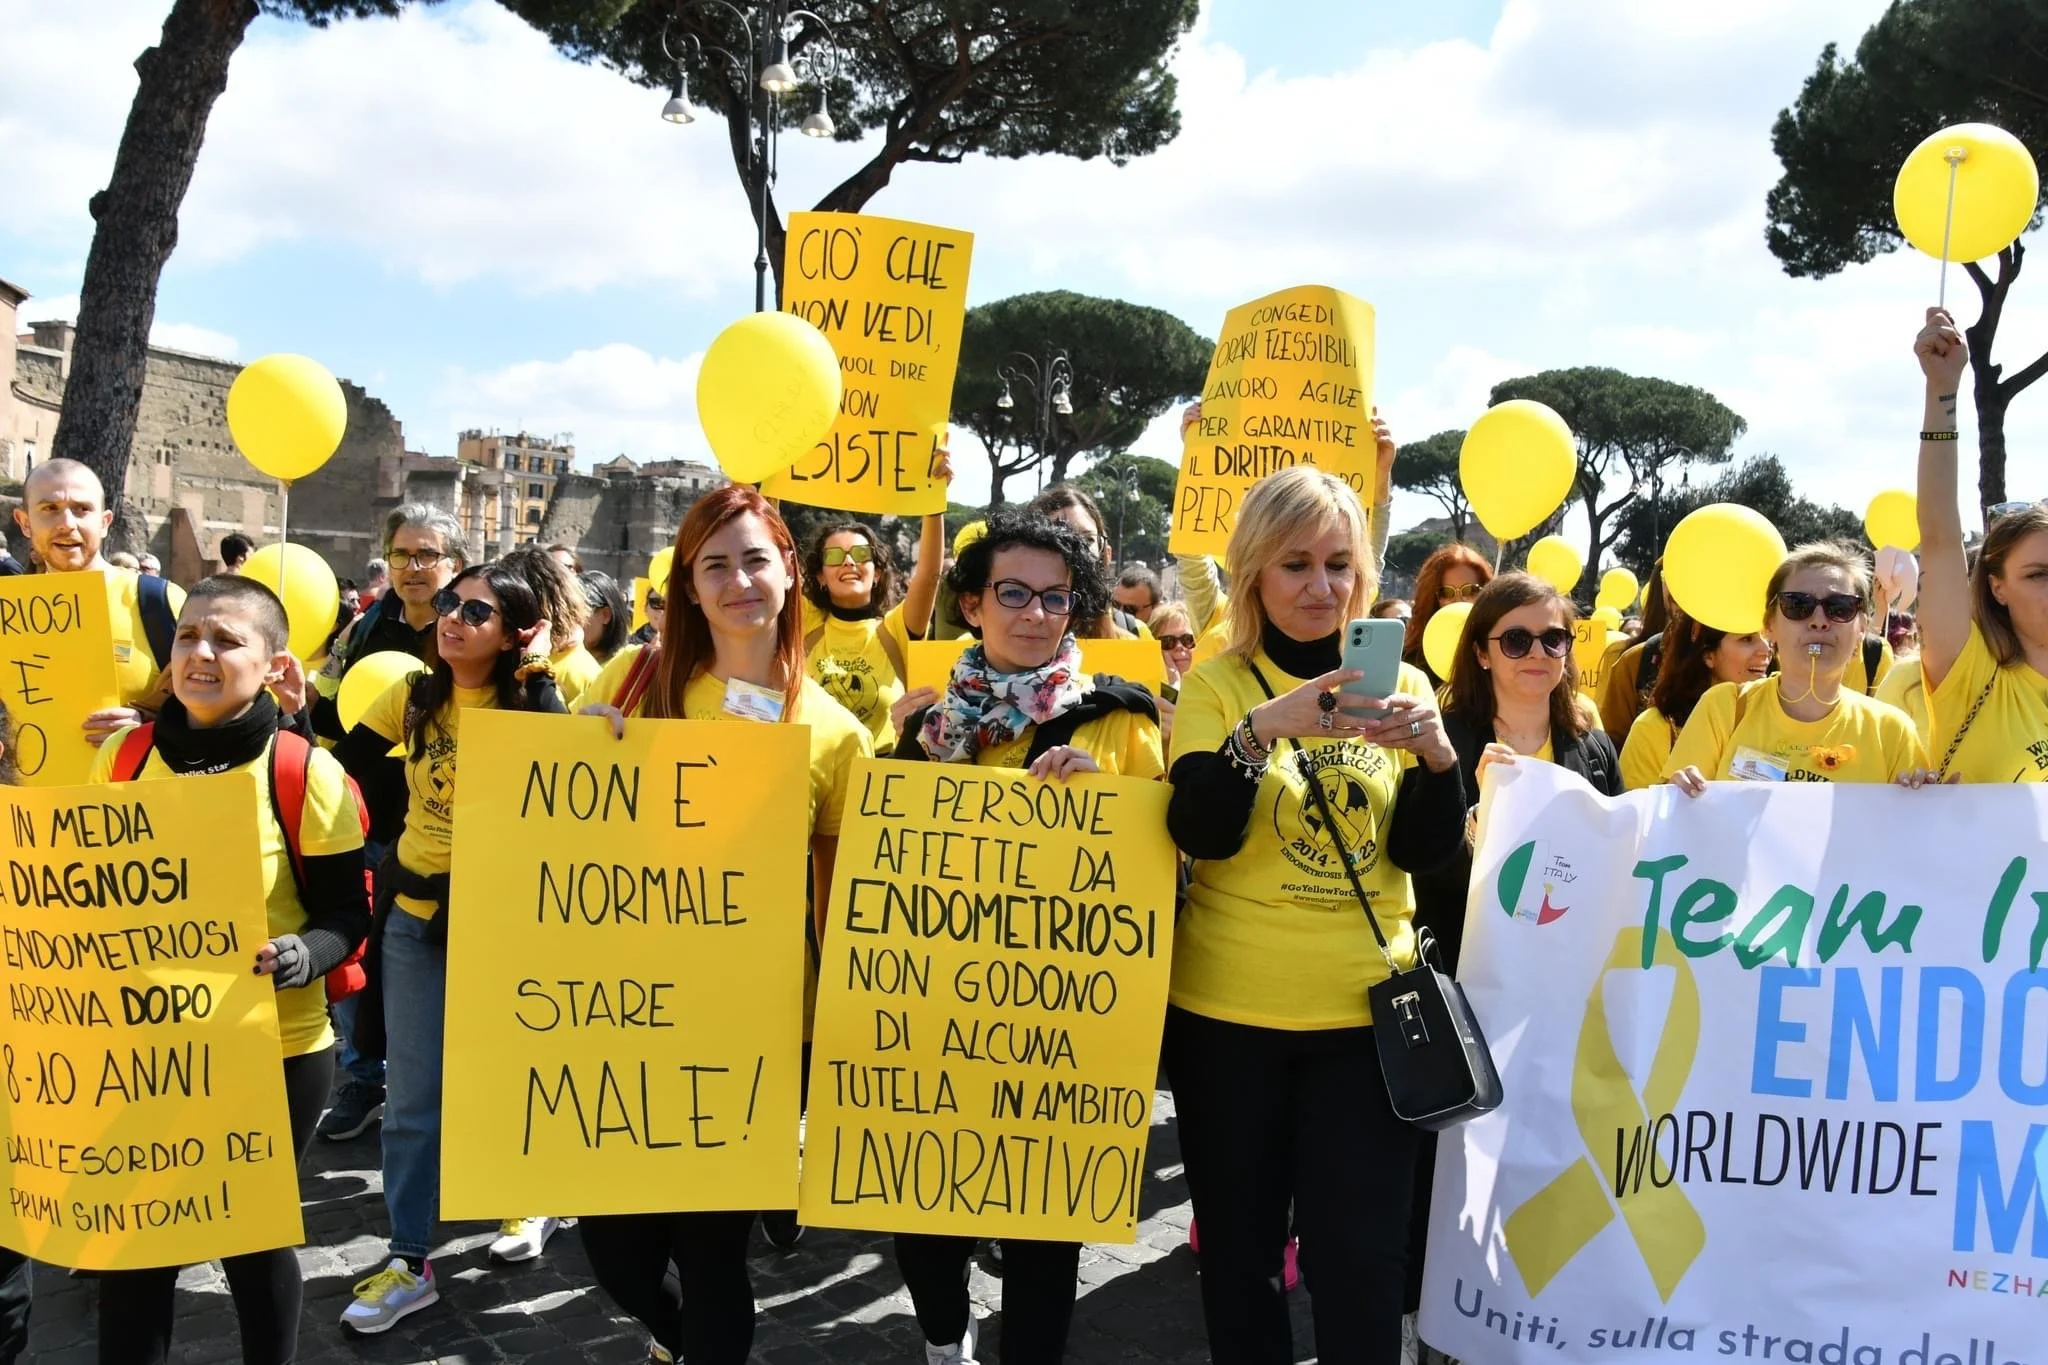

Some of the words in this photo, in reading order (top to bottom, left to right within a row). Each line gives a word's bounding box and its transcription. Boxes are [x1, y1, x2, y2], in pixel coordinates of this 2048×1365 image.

[886, 236, 955, 289] CHE
[864, 301, 941, 352] VEDI,
[1251, 303, 1334, 326] CONGEDI
[890, 360, 928, 382] DIRE
[1216, 331, 1258, 369] ORARI
[1266, 328, 1357, 369] FLESSIBILI
[1205, 376, 1278, 403] LAVORO
[1299, 379, 1362, 408] AGILE
[1199, 416, 1229, 438] PER
[1243, 415, 1357, 448] GARANTIRE
[1189, 456, 1203, 477] IL
[1214, 445, 1295, 478] DIRITTO
[1301, 451, 1317, 465] AL
[1180, 485, 1233, 534] PER
[521, 761, 639, 822] NON
[860, 772, 906, 817] LE
[932, 775, 1119, 835] PERSONE
[11, 804, 36, 848] IN
[51, 802, 154, 848] MEDIA
[873, 827, 1038, 889] AFFETTE
[1069, 845, 1116, 893] DA
[1291, 838, 1328, 868] 2014
[9, 857, 189, 909] DIAGNOSI
[538, 861, 747, 926] NORMALE
[845, 878, 1158, 959] ENDOMETRIOSI
[1632, 854, 1923, 970] Team
[3, 920, 239, 971] ENDOMETRIOSI
[10, 983, 113, 1028] ARRIVA
[120, 984, 212, 1026] DOPO
[515, 979, 675, 1031] STARE
[848, 946, 930, 998] NON
[954, 960, 1117, 1015] GODONO
[875, 1009, 911, 1052] DI
[942, 1018, 1078, 1070] ALCUNA
[3, 1044, 76, 1105] 8-10
[95, 1041, 211, 1107] ANNI
[828, 1060, 958, 1114] TUTELA
[992, 1080, 1024, 1120] IN
[1032, 1081, 1146, 1129] AMBITO
[523, 1056, 763, 1155] MALE!
[8, 1134, 205, 1176] DALL'ESORDIO
[227, 1132, 274, 1163] DEI
[831, 1126, 1140, 1228] LAVORATIVO!
[1614, 1111, 1942, 1198] WORLDWIDE
[9, 1187, 62, 1228] PRIMI
[73, 1181, 231, 1234] SINTOMI!
[1454, 1278, 1568, 1350] Uniti,
[1587, 1316, 1696, 1352] sulla
[1718, 1324, 1882, 1365] strada
